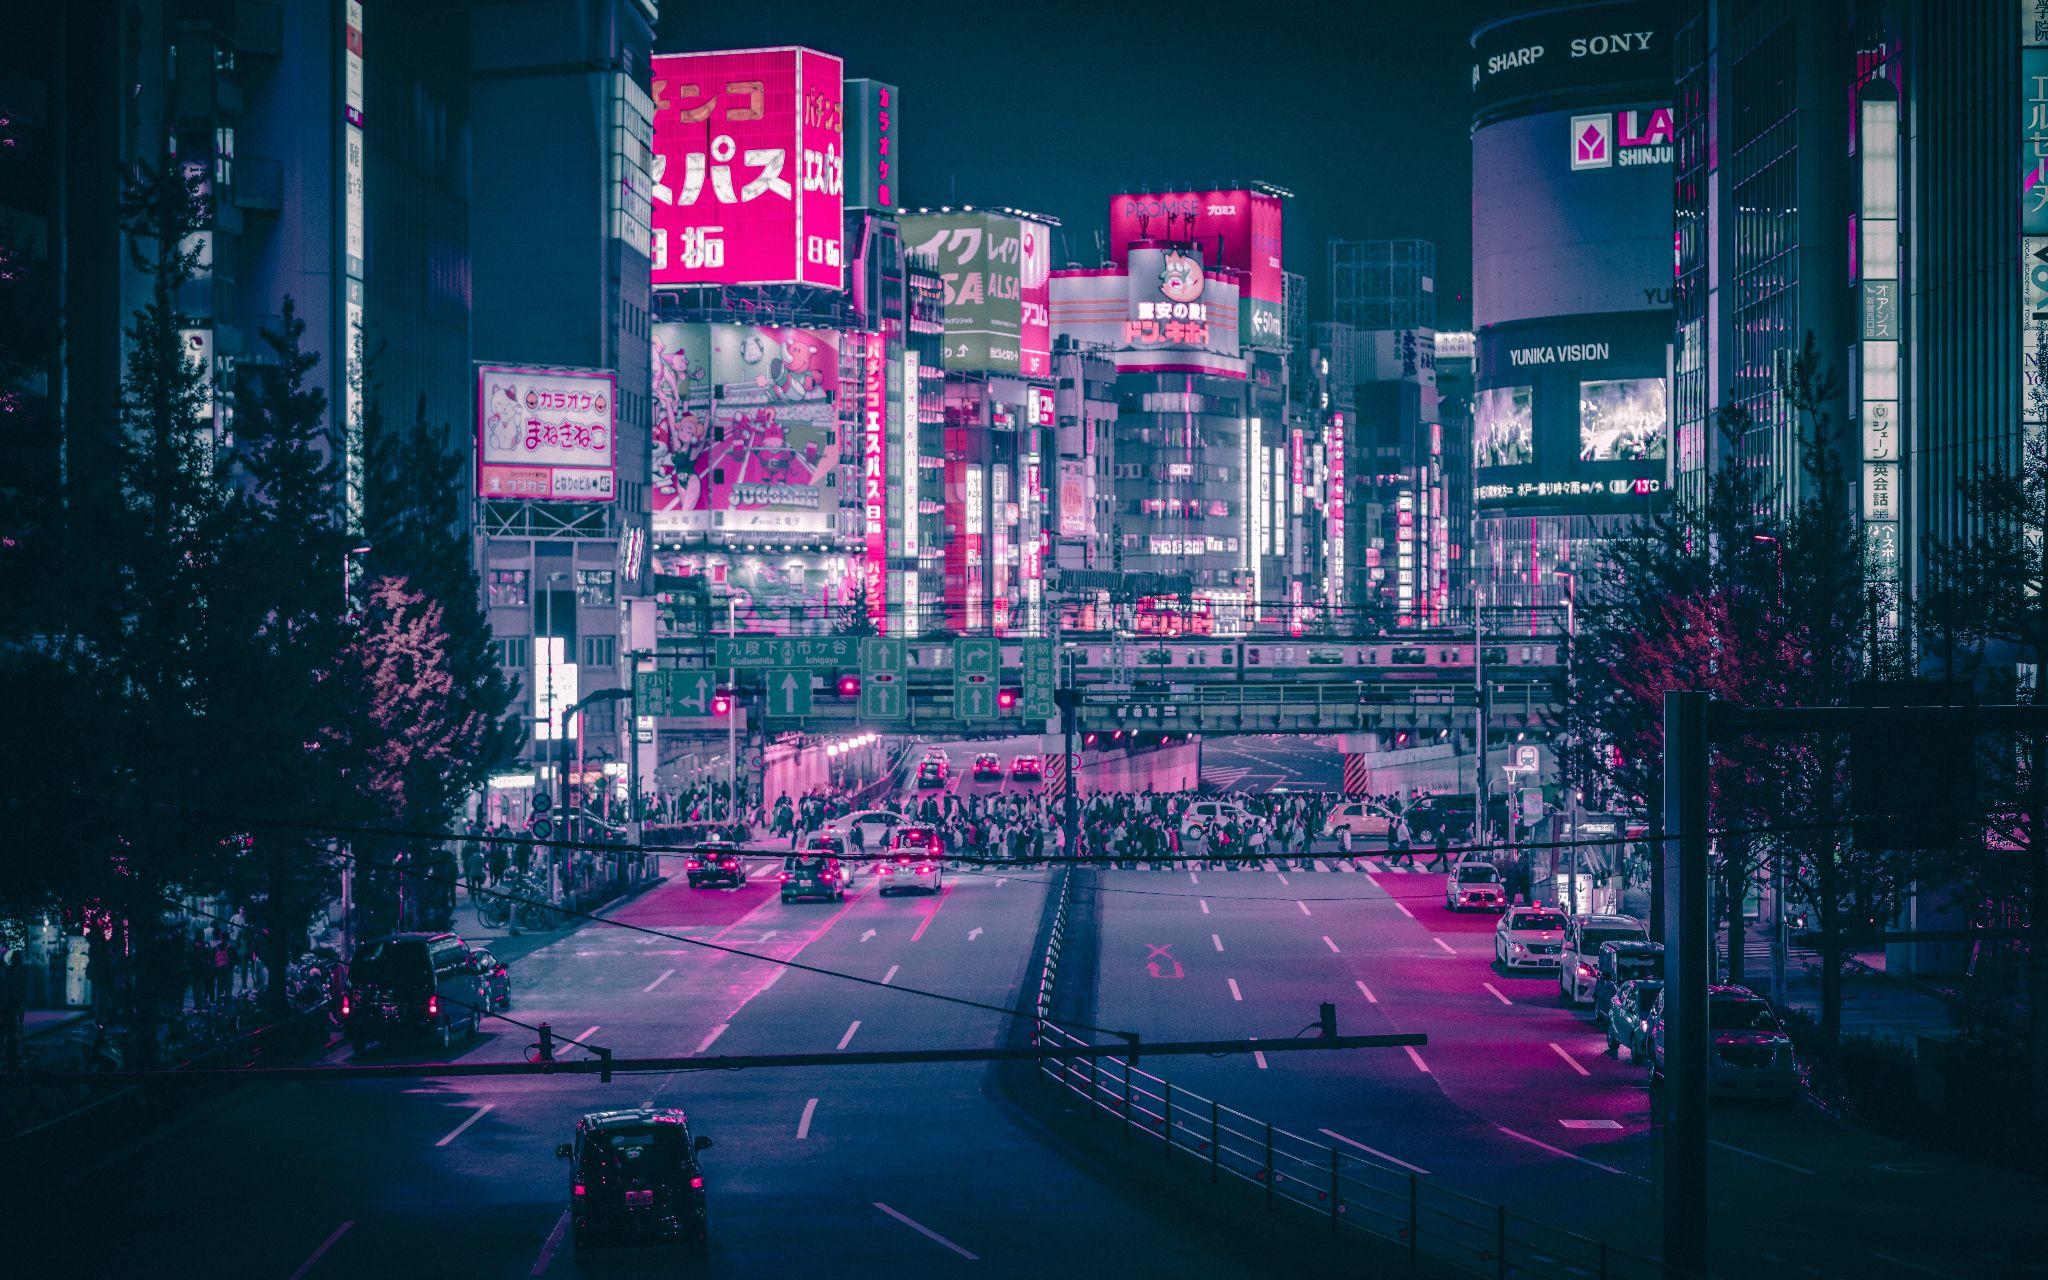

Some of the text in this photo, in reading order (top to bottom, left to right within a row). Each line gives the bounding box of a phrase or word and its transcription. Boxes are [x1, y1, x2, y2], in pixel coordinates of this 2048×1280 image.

[1570, 31, 1654, 58] SONY
[1487, 45, 1545, 75] SHARP
[1618, 147, 1674, 166] SHINJU
[1125, 200, 1200, 217] PROMISE
[1206, 204, 1237, 216] プロミス
[987, 232, 1020, 265] レイク
[988, 272, 1020, 301] ALSA
[1021, 301, 1049, 327] アコム
[1876, 283, 1889, 337] オアシス
[1510, 342, 1610, 367] YUNIKA VISION
[867, 342, 880, 407] パチンコ
[540, 391, 592, 410] カラオケ
[525, 417, 607, 451] まねきねこ
[867, 410, 881, 499] エスパス
[554, 475, 591, 492] となりのビル
[727, 641, 778, 656] 九段下
[730, 656, 775, 665] Kudanshita
[805, 656, 839, 665] Ichigaya
[1037, 643, 1050, 715] 新宿駅東口
